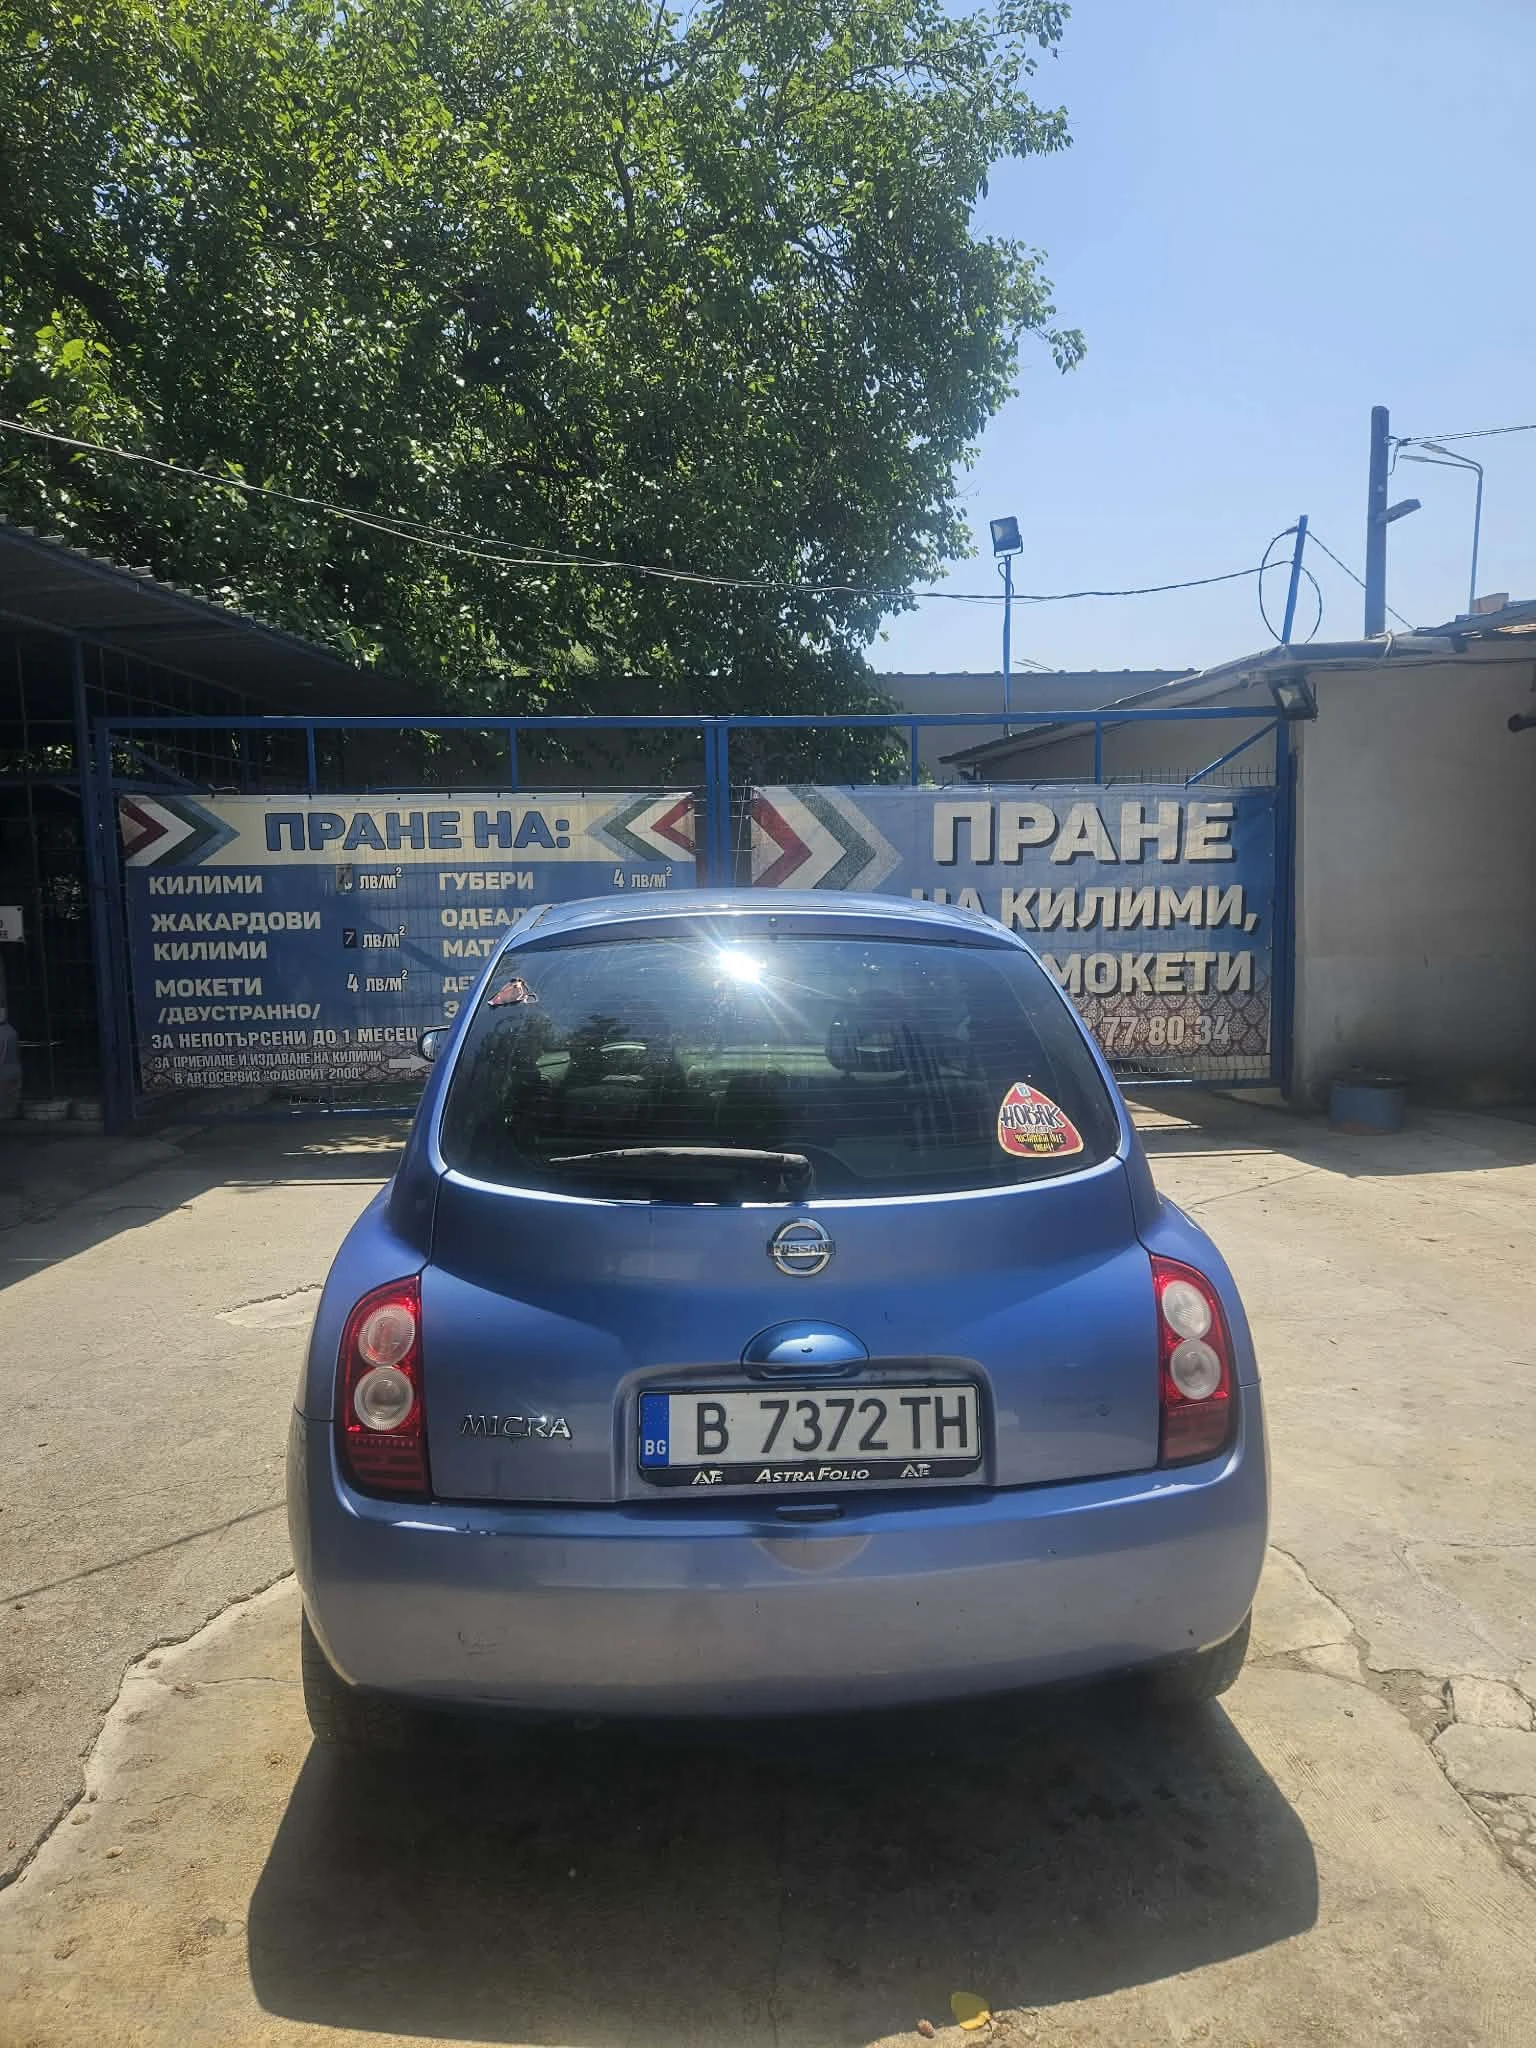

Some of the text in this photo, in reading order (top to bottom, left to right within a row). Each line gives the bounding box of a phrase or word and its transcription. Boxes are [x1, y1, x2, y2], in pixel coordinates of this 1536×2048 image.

[264, 810, 570, 851] ПРАНЕ НА:
[933, 801, 1236, 863] ПРАНЕ
[149, 875, 263, 895] КИЛИМИ
[439, 871, 534, 891] ГУБЕРИ
[613, 868, 625, 888] 4
[1001, 884, 1258, 932] КИЛИМИ,
[151, 911, 321, 934] ЖАКАРДОВИ
[344, 931, 355, 945] 7
[443, 939, 499, 957] МАТ
[153, 941, 267, 961] КИЛИМИ
[347, 973, 359, 992] 4
[1042, 952, 1253, 994] МОКЕТИ
[155, 977, 262, 998] МОКЕТИ
[158, 1003, 321, 1025] /ДВУСТРАННО/
[151, 1027, 418, 1049] ЗА НЕПОТЪРСЕНИ ДО 1 МЕСЕЦ
[1102, 1016, 1141, 1046] 77
[1150, 1015, 1184, 1046] 80
[1196, 1015, 1231, 1045] 34
[155, 1057, 170, 1069] ЗА
[174, 1054, 236, 1068] ПРИЕМАНЕ
[314, 1050, 330, 1063] НА
[332, 1050, 382, 1063] КИЛИМИ
[187, 1070, 261, 1084] АВТОСЕРВИЗ
[774, 1242, 832, 1256] NISSAN
[462, 1414, 572, 1438] MICRA
[696, 1395, 968, 1456] B 7372 TH
[644, 1439, 667, 1456] BG
